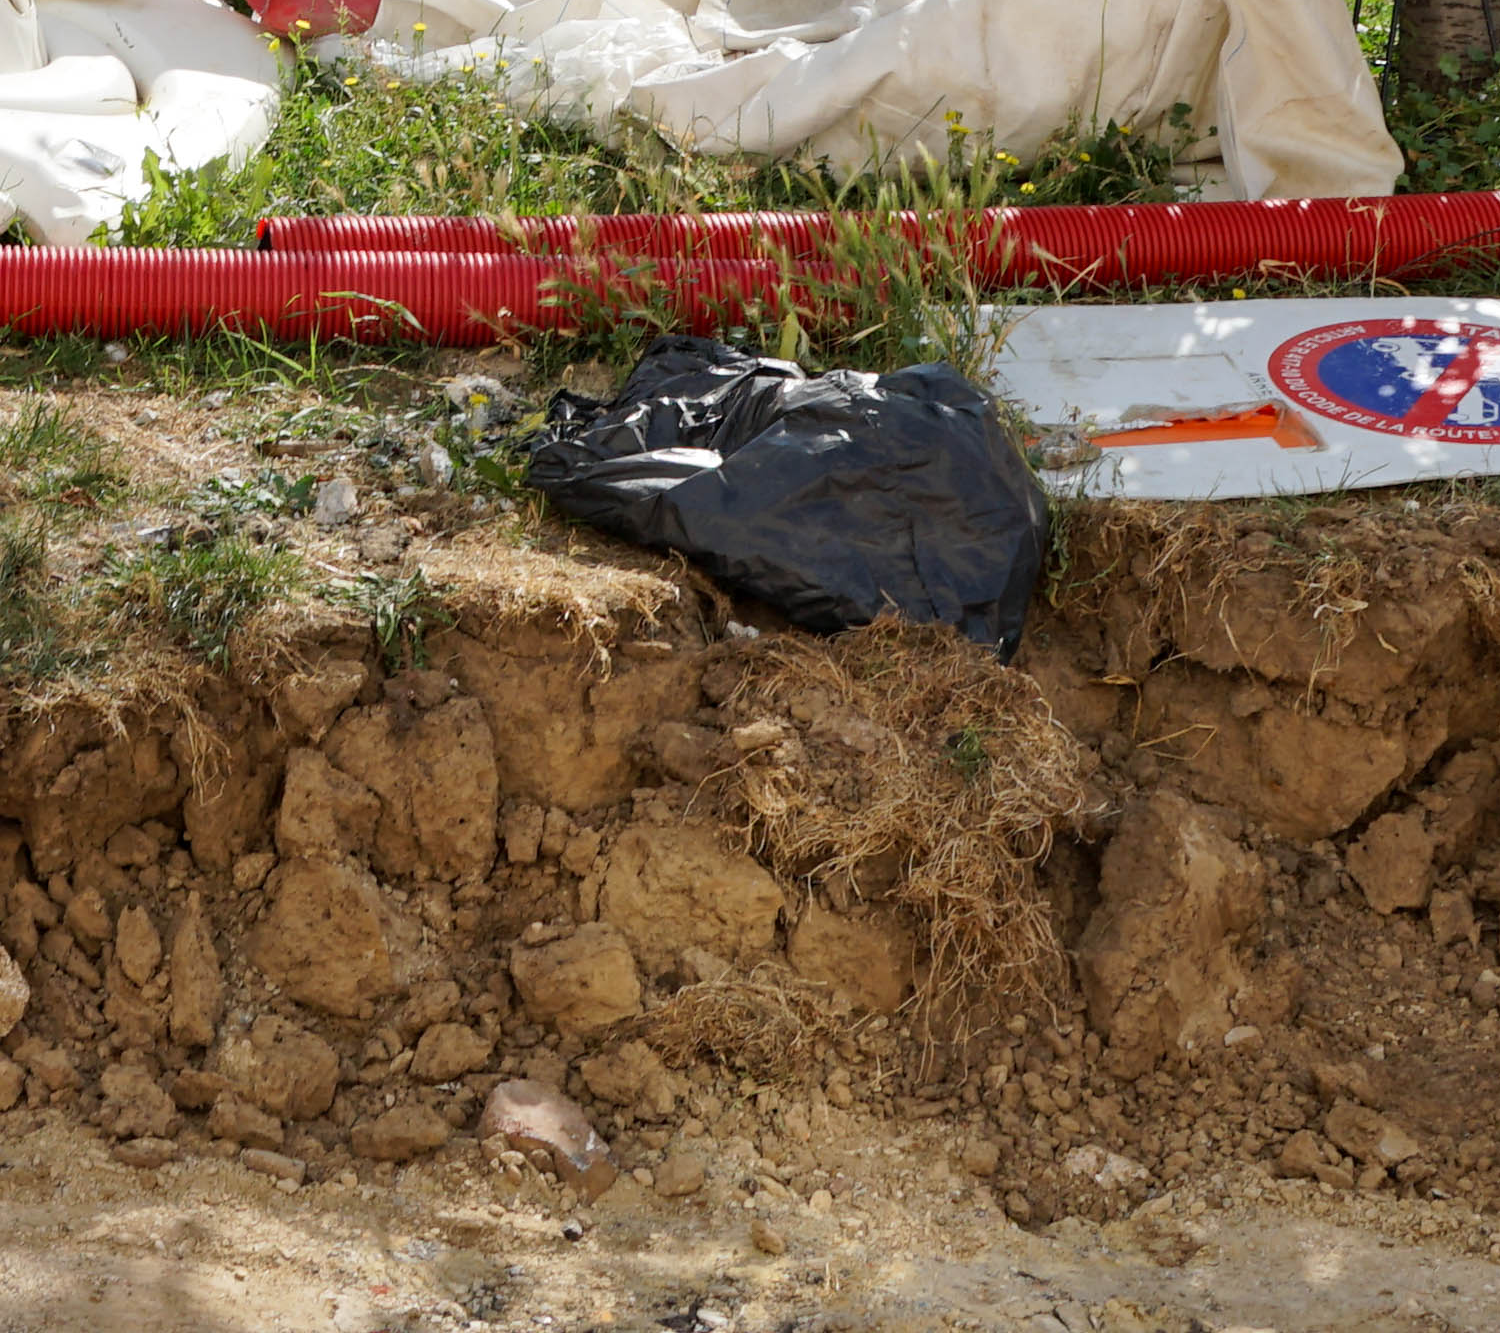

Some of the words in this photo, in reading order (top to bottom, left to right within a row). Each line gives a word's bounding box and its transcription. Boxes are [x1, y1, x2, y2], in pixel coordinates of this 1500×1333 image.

[1297, 325, 1366, 349] ARTICLE
[1284, 378, 1311, 391] DU
[1298, 391, 1348, 415] CODE
[1343, 412, 1377, 425] DE
[1376, 420, 1405, 434] LA
[1412, 425, 1494, 440] ROUTE
